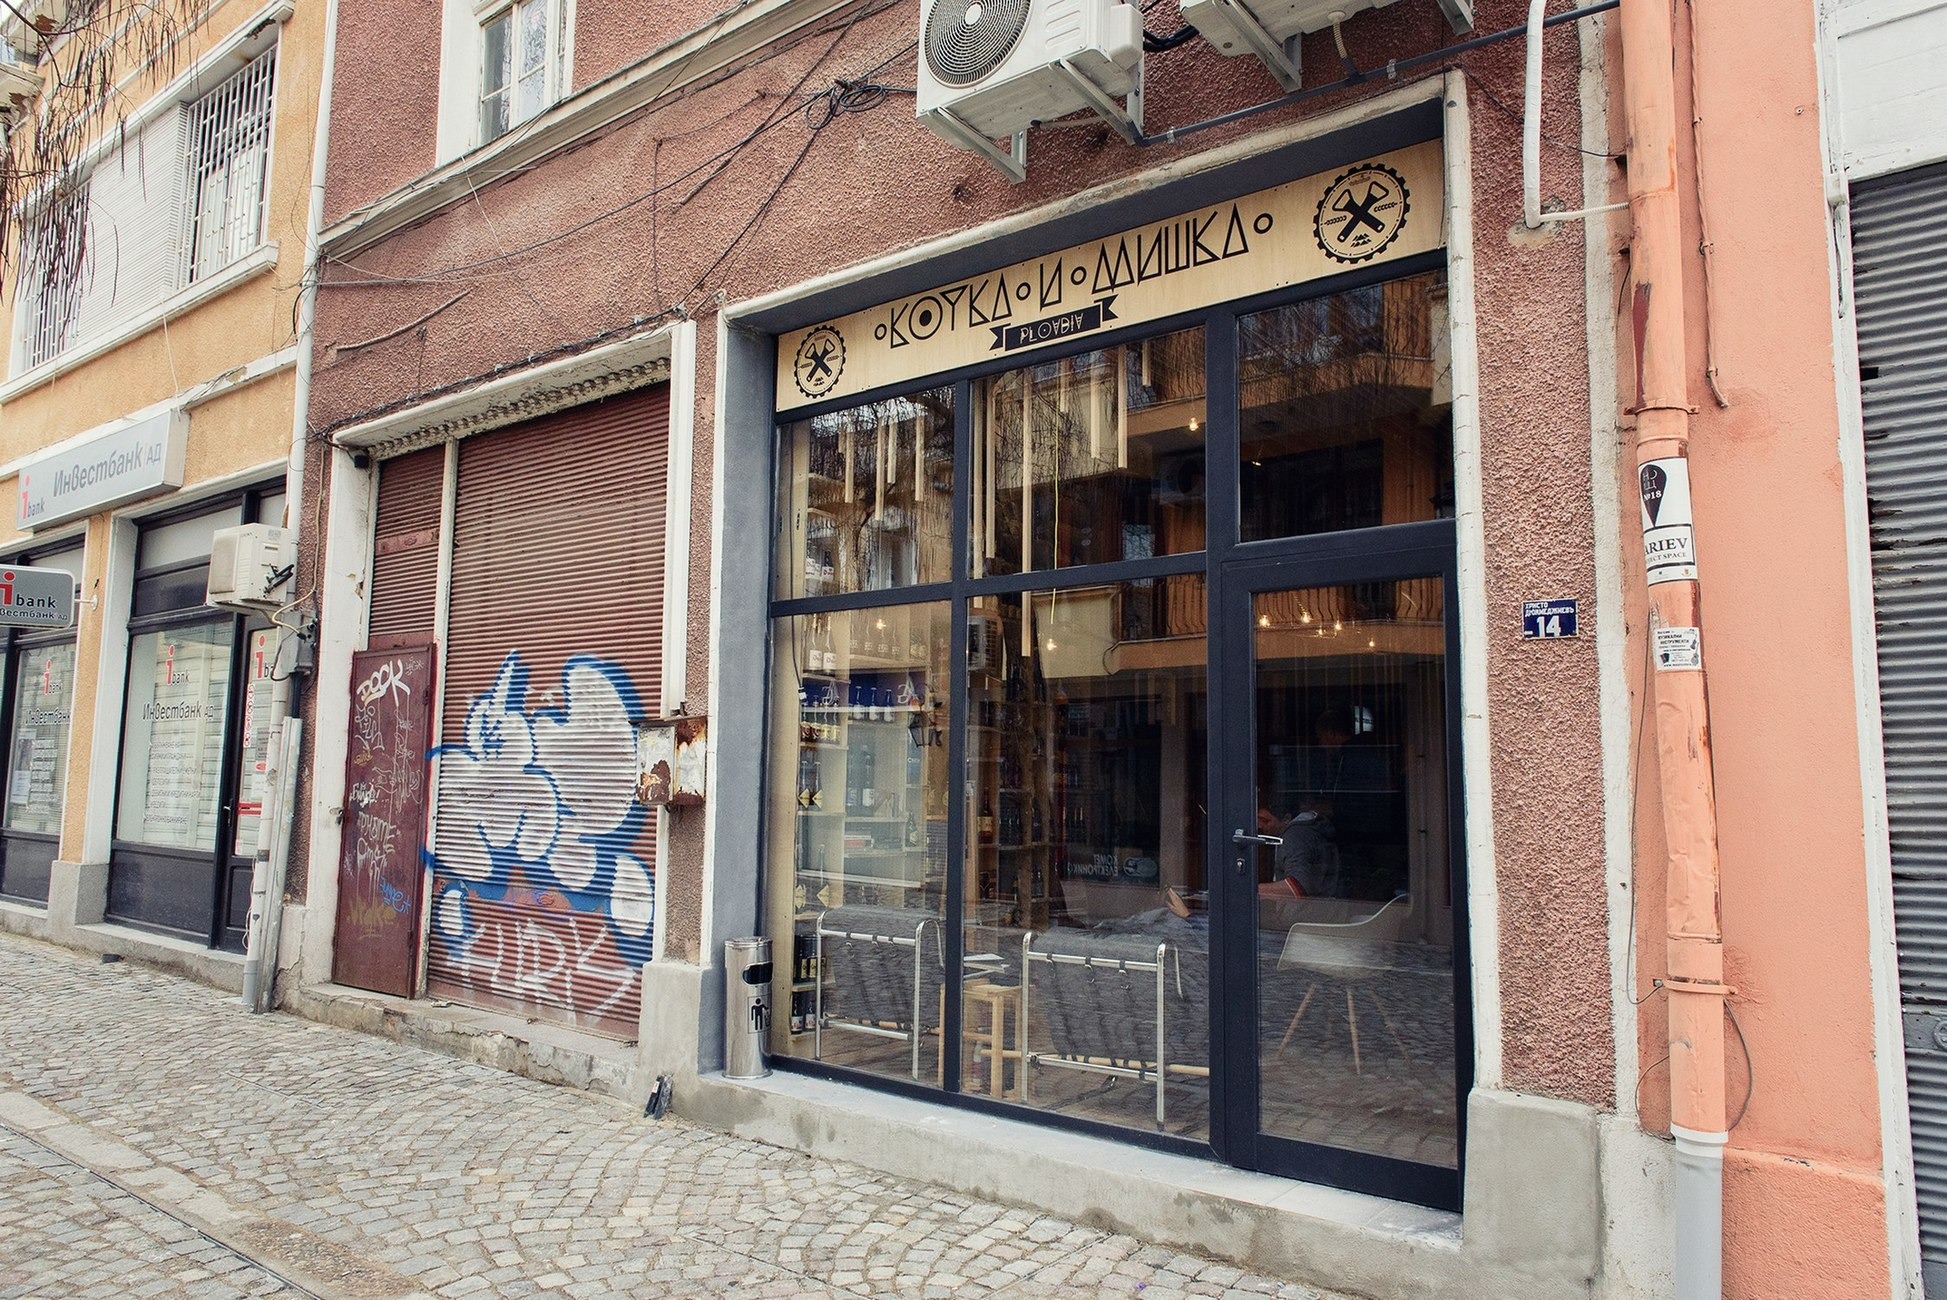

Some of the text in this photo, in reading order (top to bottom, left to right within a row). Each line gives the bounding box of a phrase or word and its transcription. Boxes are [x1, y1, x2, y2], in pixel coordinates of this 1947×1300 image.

[1039, 256, 1063, 312] И
[1091, 202, 1250, 294] МИШКА
[146, 443, 162, 466] АД
[16, 593, 56, 608] bank
[1536, 615, 1561, 638] 14
